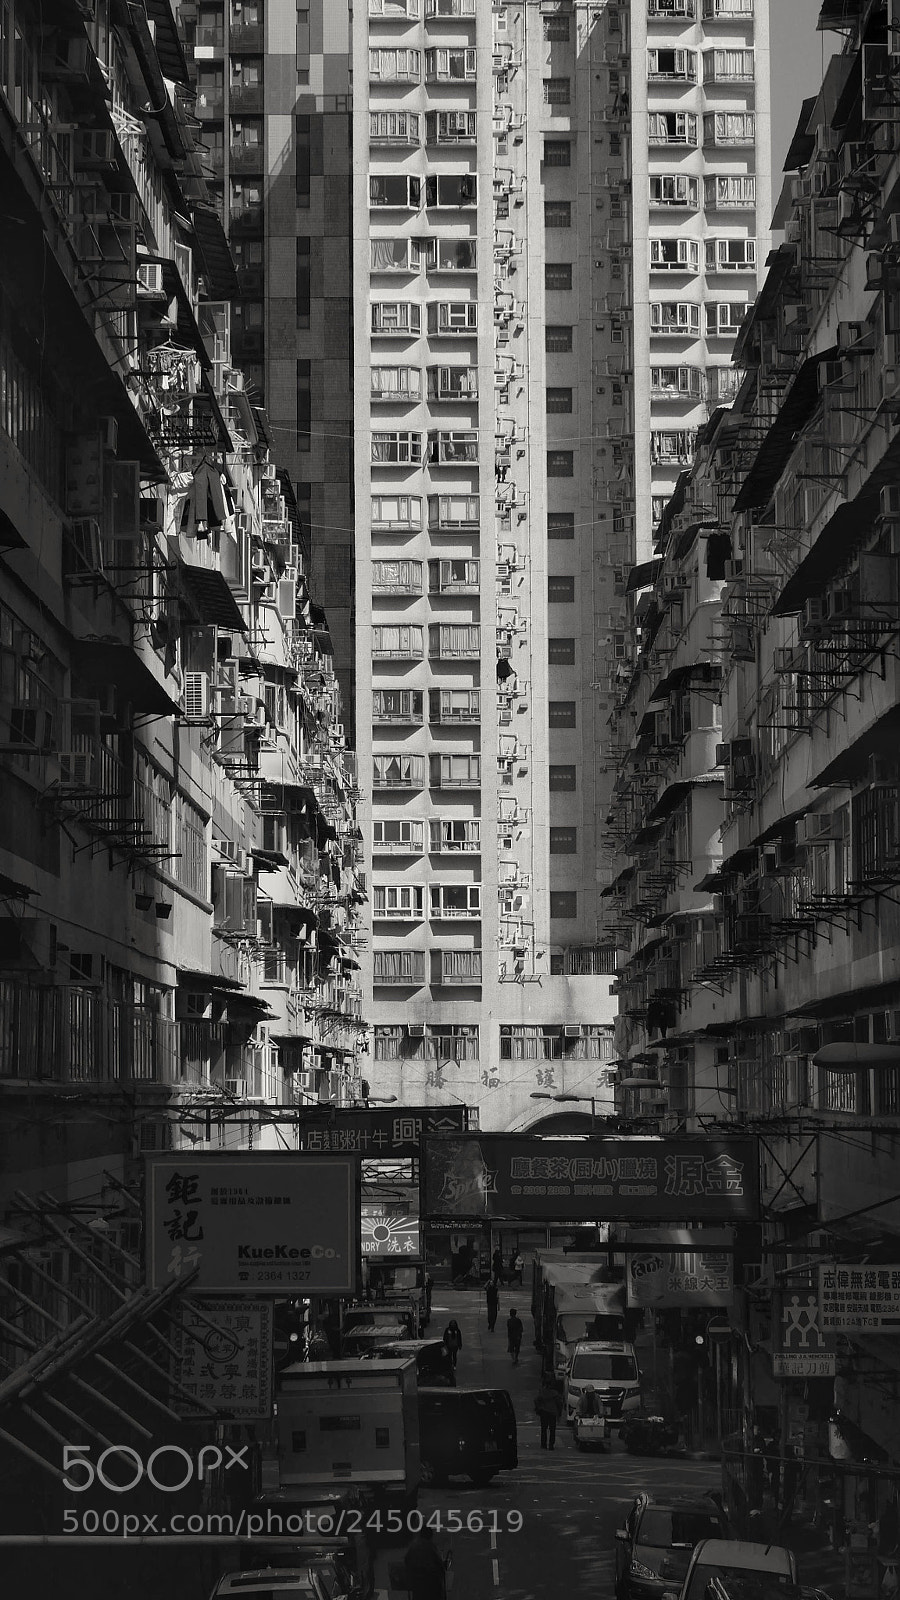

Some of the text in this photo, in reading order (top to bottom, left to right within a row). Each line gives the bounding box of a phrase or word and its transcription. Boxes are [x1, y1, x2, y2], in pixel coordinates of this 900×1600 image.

[387, 1236, 417, 1253] 洗衣
[286, 1271, 311, 1281] 1327
[669, 1276, 729, 1291] 米線大王
